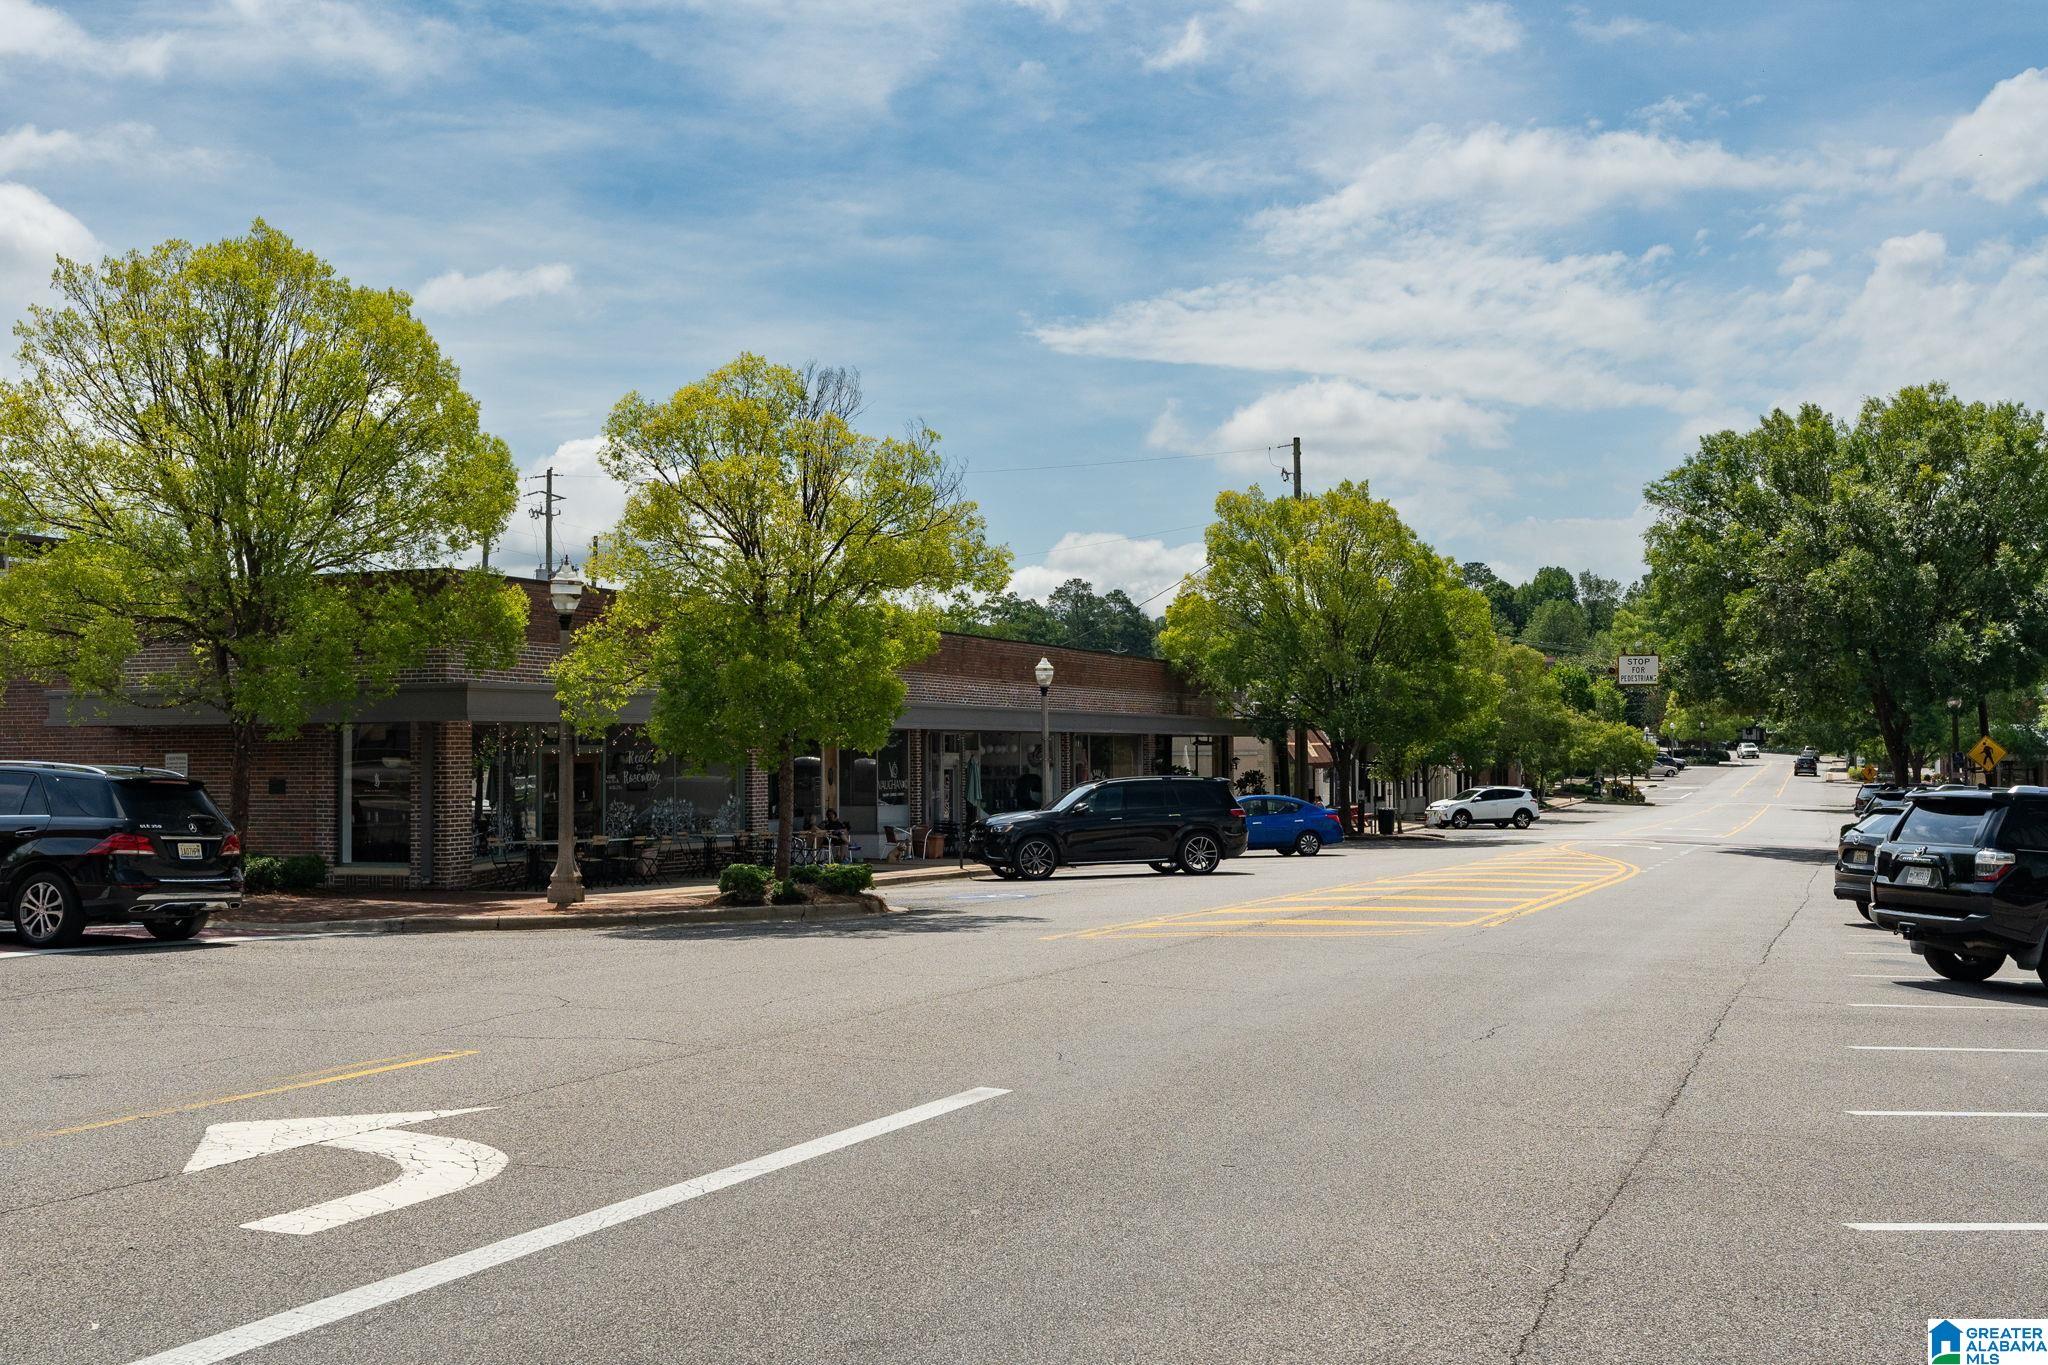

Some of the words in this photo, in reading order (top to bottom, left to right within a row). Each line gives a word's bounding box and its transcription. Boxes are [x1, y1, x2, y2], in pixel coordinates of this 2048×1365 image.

[1627, 658, 1650, 666] STOP
[1631, 666, 1646, 674] FOR
[1620, 674, 1657, 682] PEDESTRIANS
